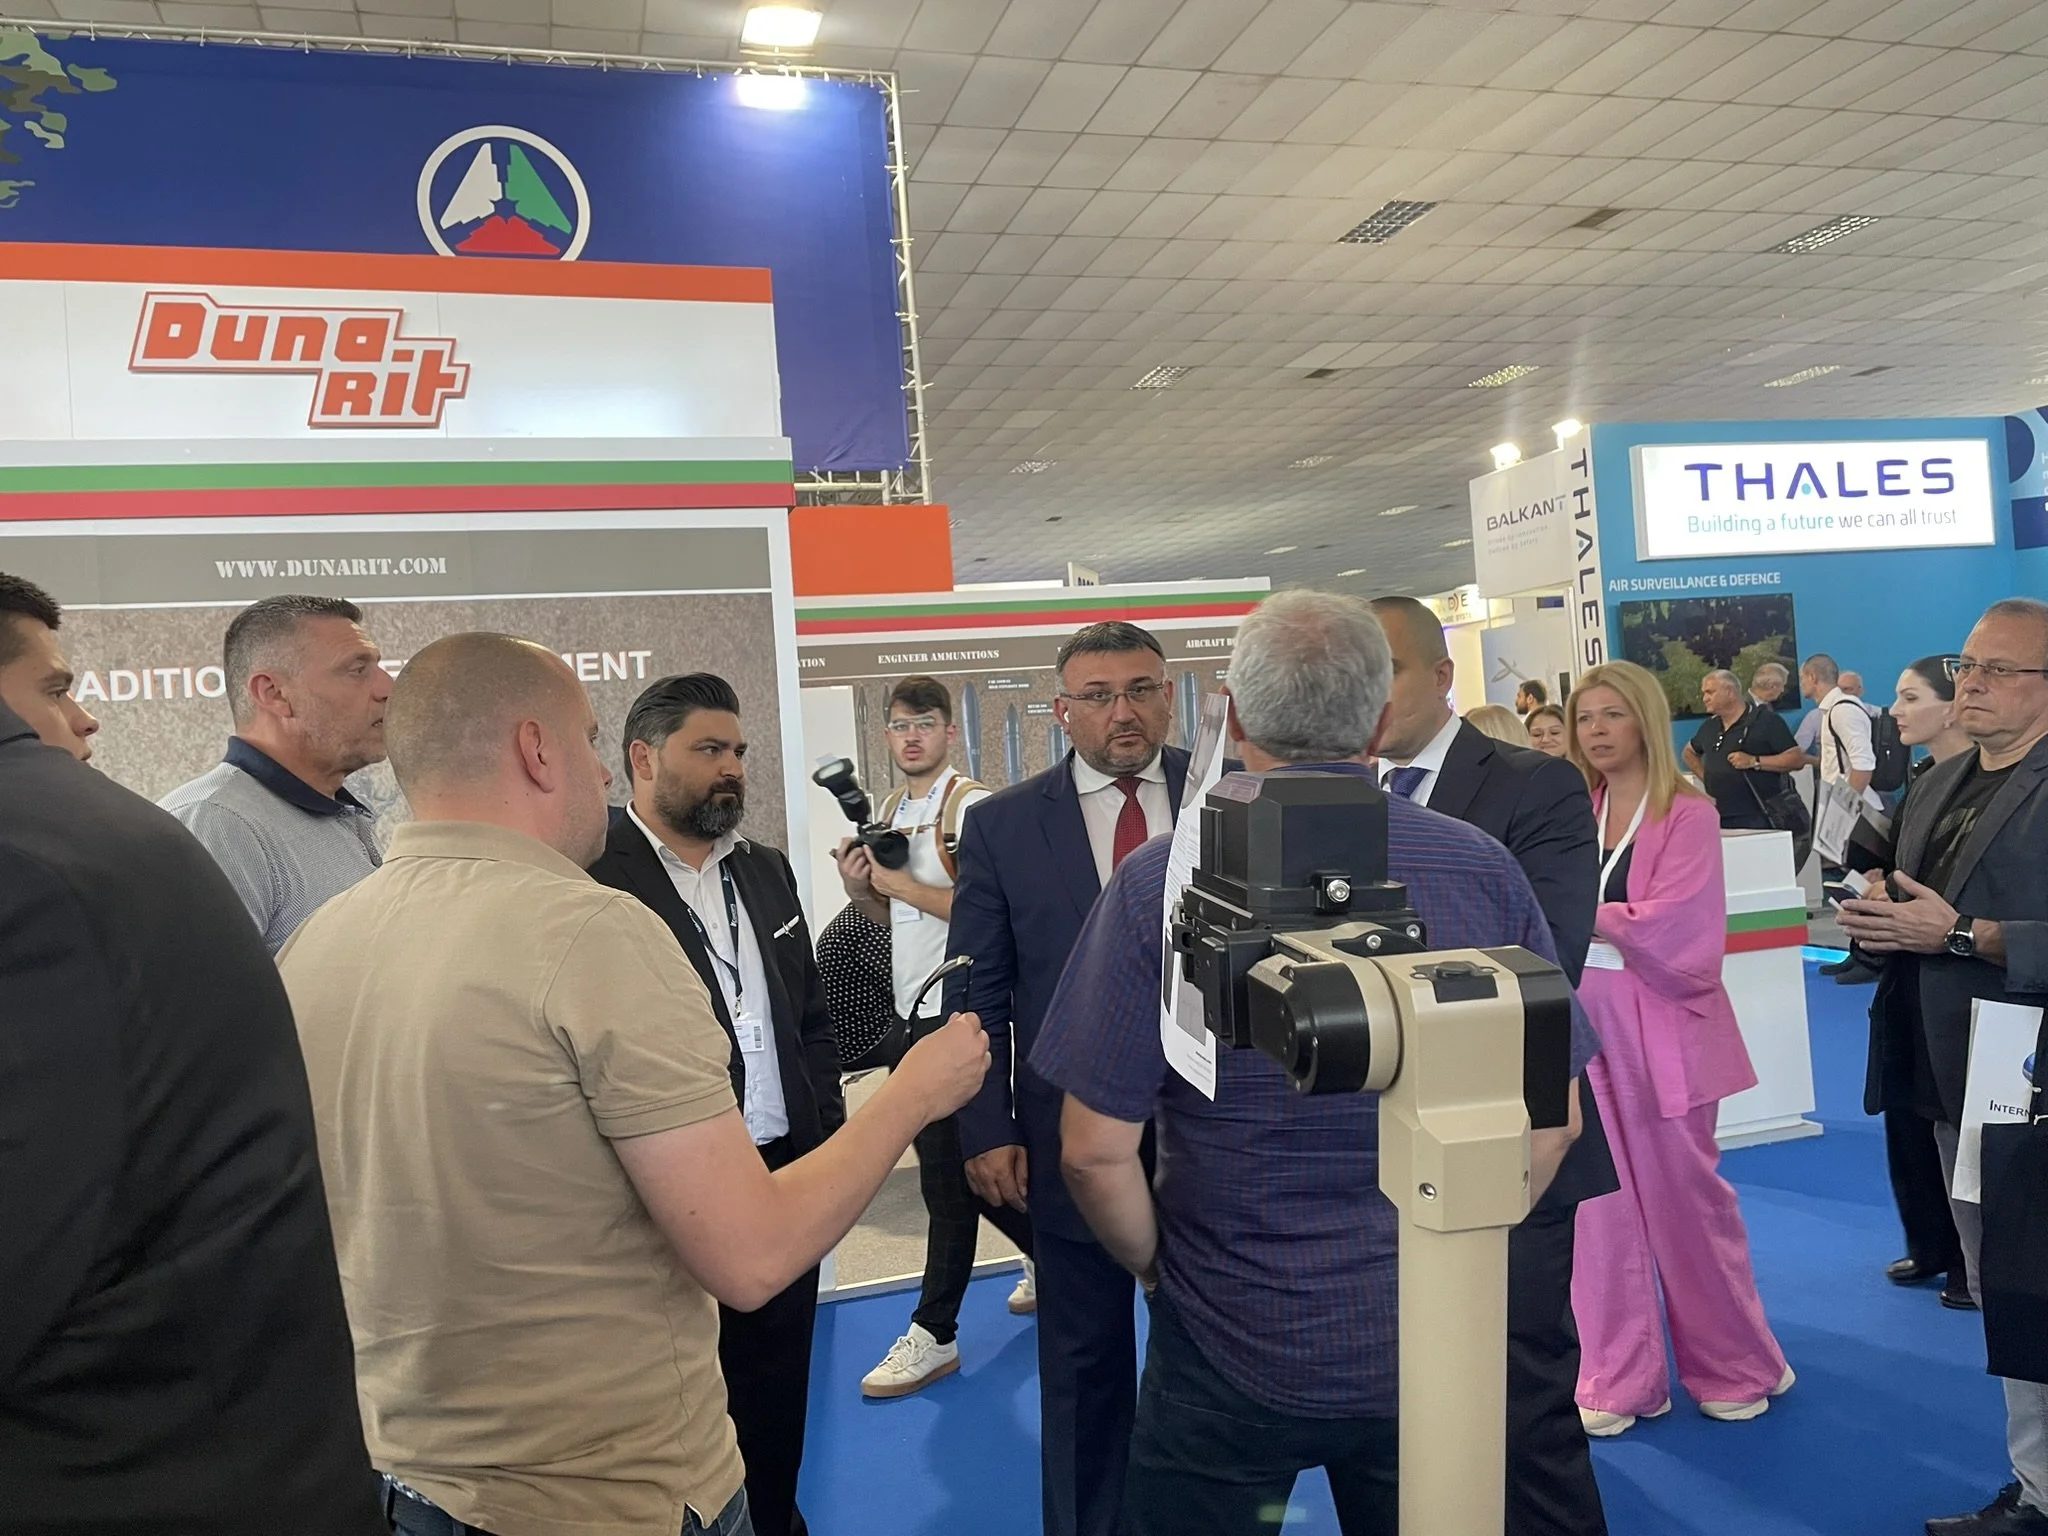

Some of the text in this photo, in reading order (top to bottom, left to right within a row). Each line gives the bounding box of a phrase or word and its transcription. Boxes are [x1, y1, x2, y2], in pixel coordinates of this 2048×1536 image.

[1684, 457, 1955, 501] THALES
[1687, 508, 1957, 536] Building a future we can all trust
[214, 556, 448, 579] WWW.DUNARIT.COM
[1571, 447, 1603, 666] THALES
[1609, 572, 1781, 592] AIR SURVEILLANCE & DEFENCE
[799, 657, 826, 668] TION
[877, 649, 1000, 665] ENGINEER AMMUNITIONS
[74, 665, 227, 702] ADITIO
